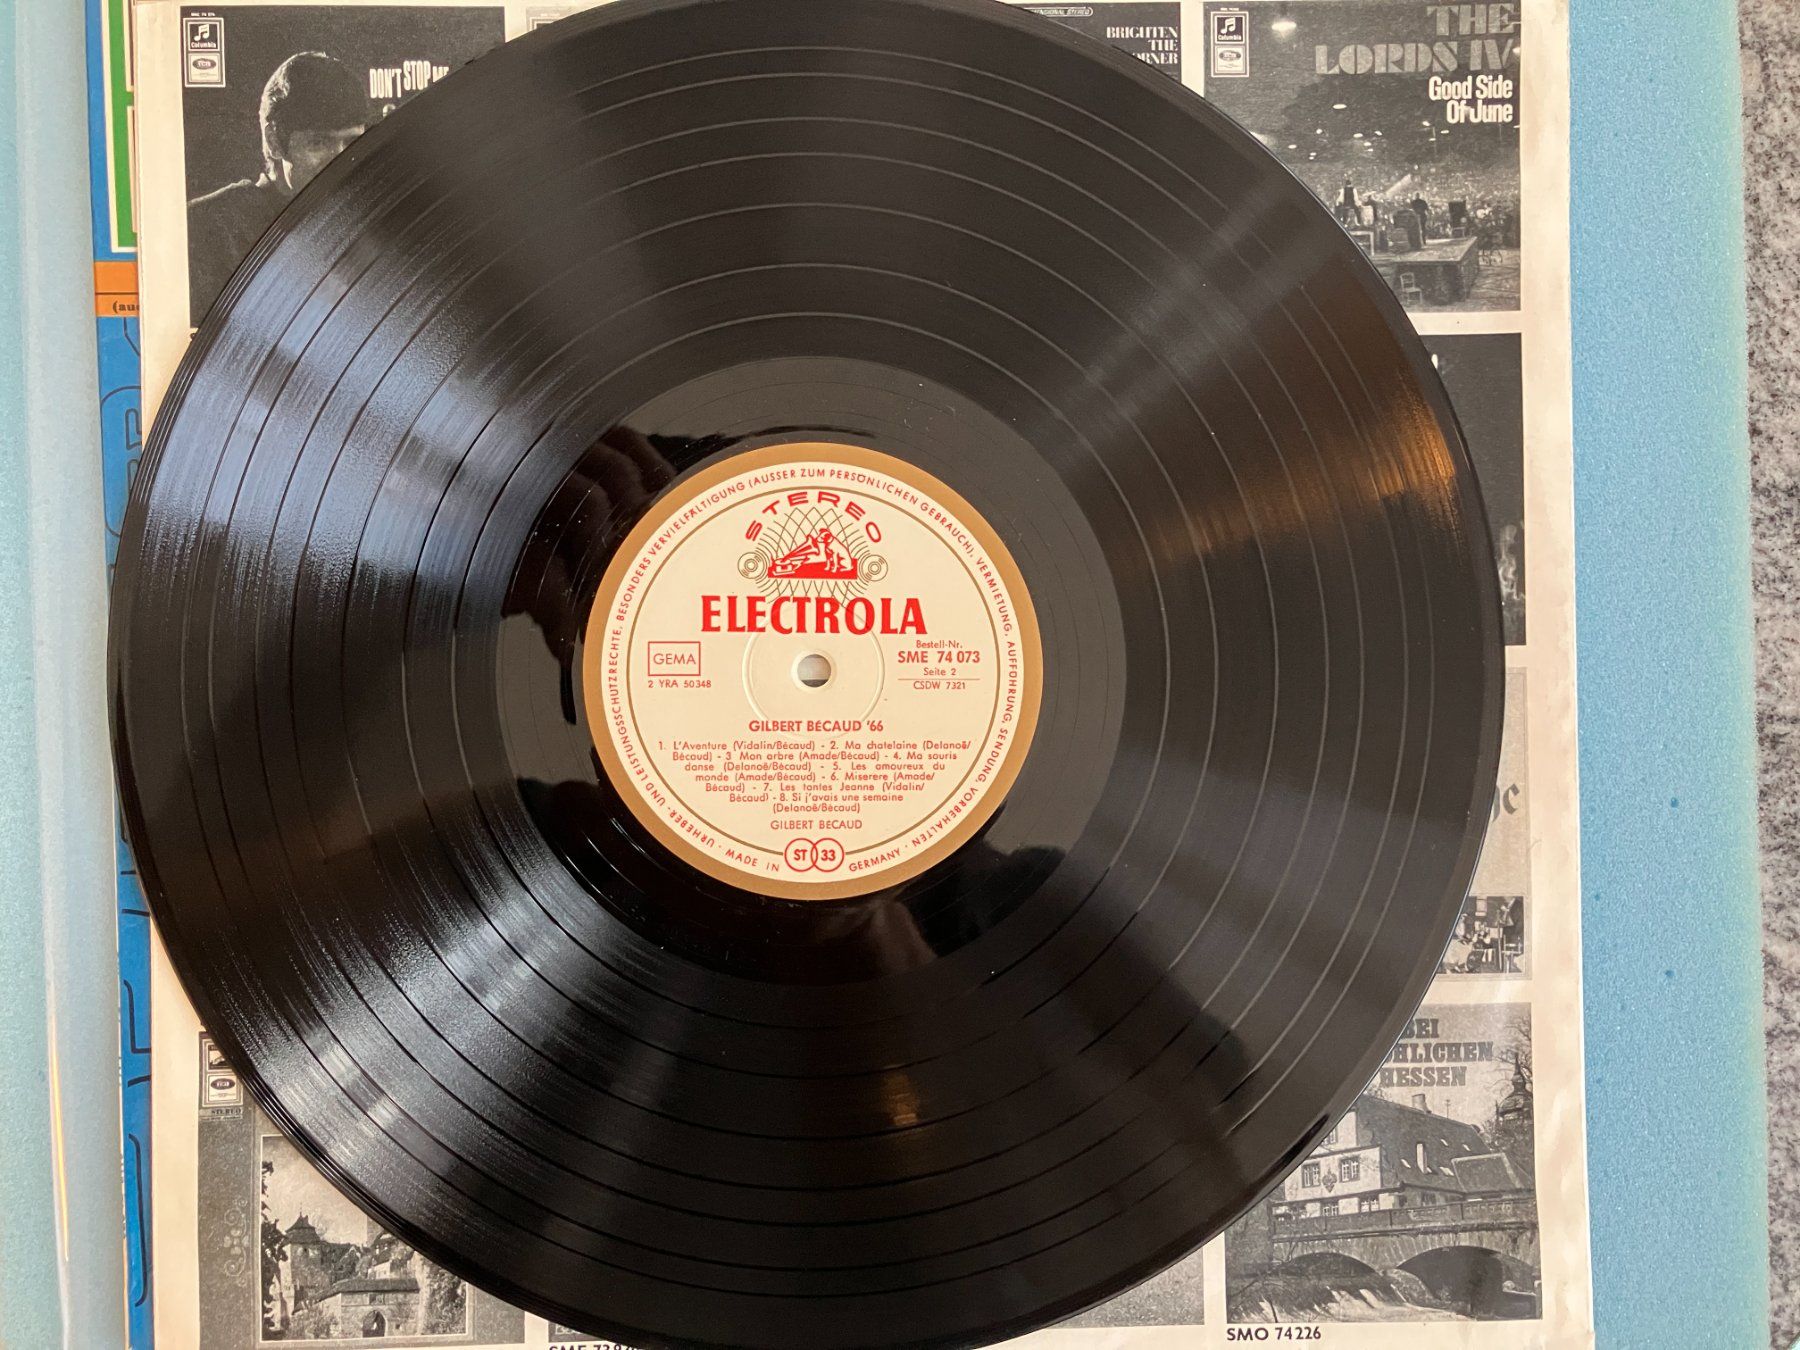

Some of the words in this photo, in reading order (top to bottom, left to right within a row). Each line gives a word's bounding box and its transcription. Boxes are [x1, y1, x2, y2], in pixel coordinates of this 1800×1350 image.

[1427, 3, 1515, 36] THE
[1106, 26, 1178, 39] BRIGHTEN
[1148, 39, 1178, 51] THE
[1315, 41, 1458, 75] LORDS
[1469, 38, 1514, 71] IV
[369, 68, 402, 99] DON'T
[403, 60, 431, 91] STOP
[1429, 75, 1472, 101] Good
[1475, 75, 1513, 99] Side
[1447, 101, 1468, 124] Of
[1469, 100, 1513, 123] June
[749, 469, 796, 489] (AUSSER
[800, 469, 826, 477] ZUM
[829, 469, 919, 505] PERSÖNLICHEN
[745, 490, 883, 543] STEREO
[615, 556, 652, 621] BESONDERS
[701, 595, 928, 635] ELECTROLA
[653, 653, 697, 665] GEMA
[898, 651, 928, 663] SME
[924, 667, 946, 676] Seite
[648, 680, 653, 688] 2
[659, 679, 678, 688] YRA
[913, 681, 940, 689] CSDW
[749, 720, 802, 732] GILBERT
[807, 720, 862, 732] BÉCAUD
[867, 720, 883, 732] '66
[659, 741, 665, 750] 1.
[674, 741, 727, 750] L'Aventure
[830, 740, 838, 750] 2.
[845, 741, 861, 749] Ma
[867, 741, 917, 750] chatelaine
[923, 740, 971, 752] (Delanoë/
[673, 751, 712, 762] Bécaud)
[740, 751, 761, 760] Mon
[767, 752, 793, 760] arbre
[893, 752, 901, 760] 4.
[928, 751, 957, 760] souris
[685, 761, 714, 771] danse
[833, 761, 841, 770] 5.
[852, 762, 866, 770] Les
[933, 762, 945, 770] du
[696, 772, 728, 781] monde
[831, 772, 839, 781] 6.
[845, 772, 888, 781] Miserere
[894, 772, 935, 782] (Amade/
[706, 783, 745, 793] Bécaud)
[764, 783, 772, 791] 7.
[781, 783, 795, 791] Les
[840, 782, 874, 791] Jeanne
[883, 782, 925, 792] (Vidalin/
[645, 782, 666, 807] UND
[730, 792, 768, 802] Bécaud)
[780, 793, 788, 801] 8.
[792, 793, 801, 801] Si
[806, 793, 838, 804] j'avais
[911, 787, 979, 848] VORBEHALTEN
[770, 820, 813, 830] GILBERT
[725, 848, 759, 867] MADE
[766, 862, 779, 872] IN
[849, 847, 901, 873] GERMANY
[794, 849, 808, 861] ST
[821, 849, 836, 862] 33
[1386, 1042, 1493, 1063] HLICHEN
[1380, 1066, 1467, 1088] HESSEN
[1227, 1328, 1269, 1341] SMO
